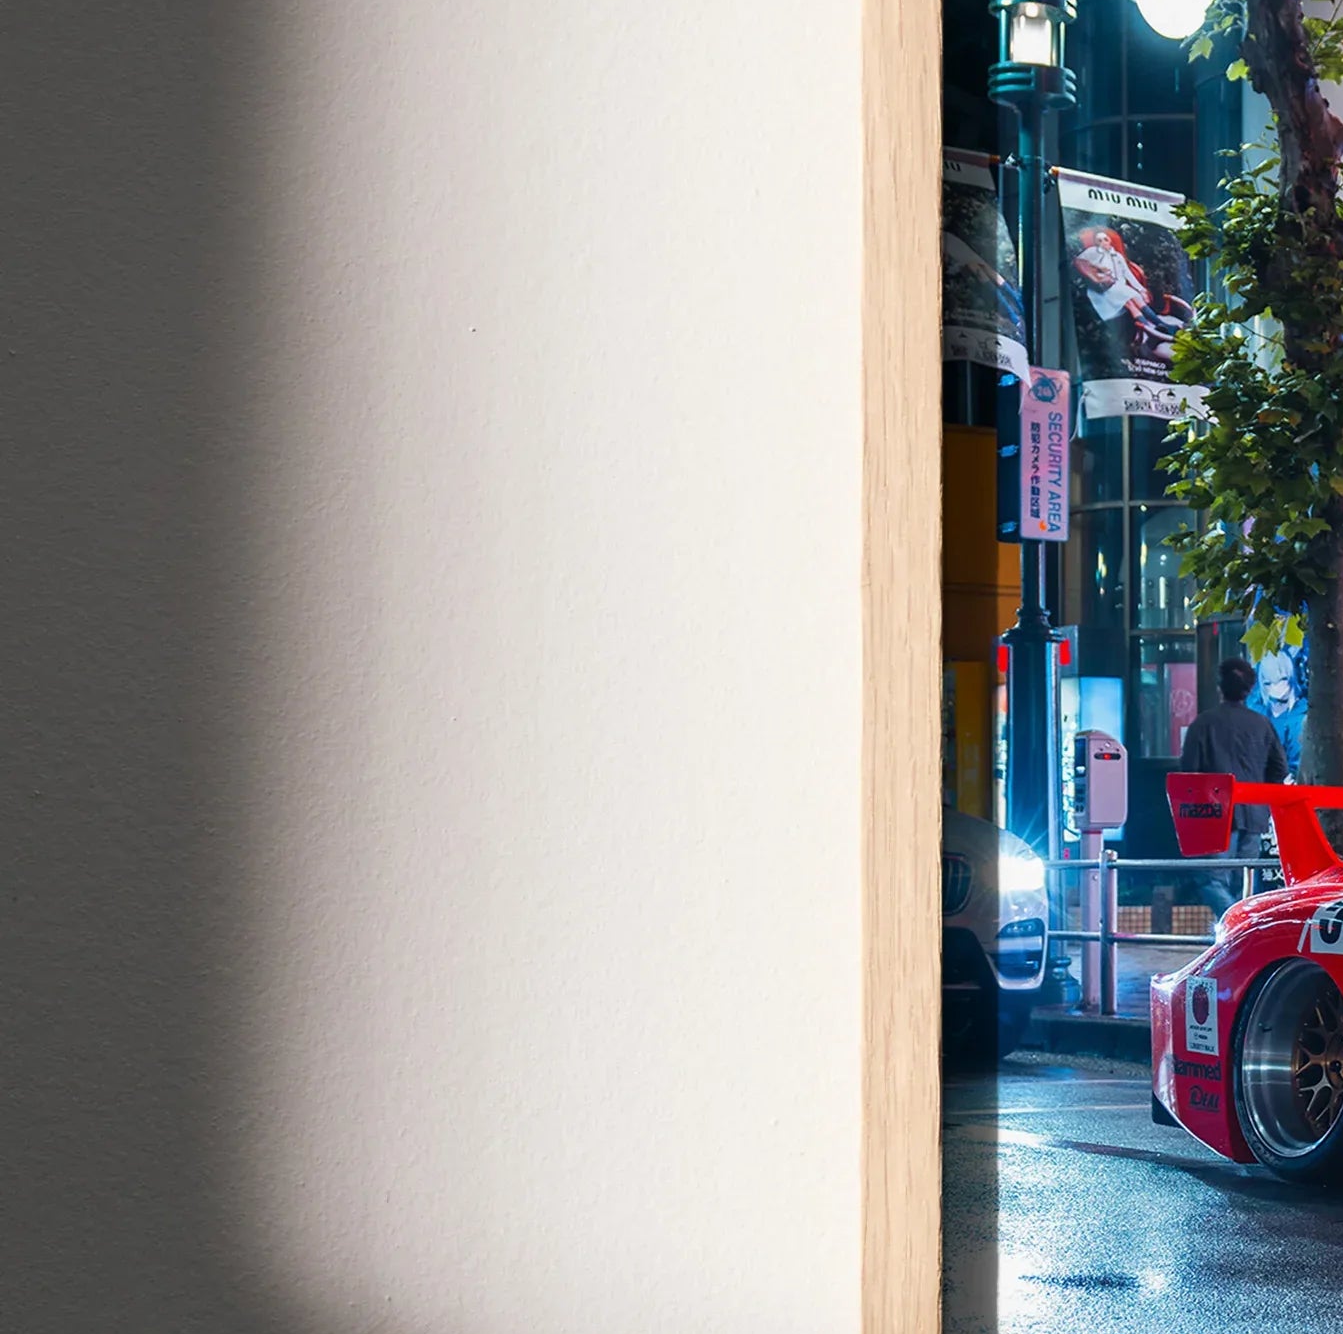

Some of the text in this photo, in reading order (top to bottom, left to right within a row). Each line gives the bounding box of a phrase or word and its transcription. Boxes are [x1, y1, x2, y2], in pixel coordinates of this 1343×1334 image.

[1088, 189, 1158, 212] miu miu
[1047, 412, 1063, 533] SECURITY AREA
[1179, 802, 1223, 819] mazda
